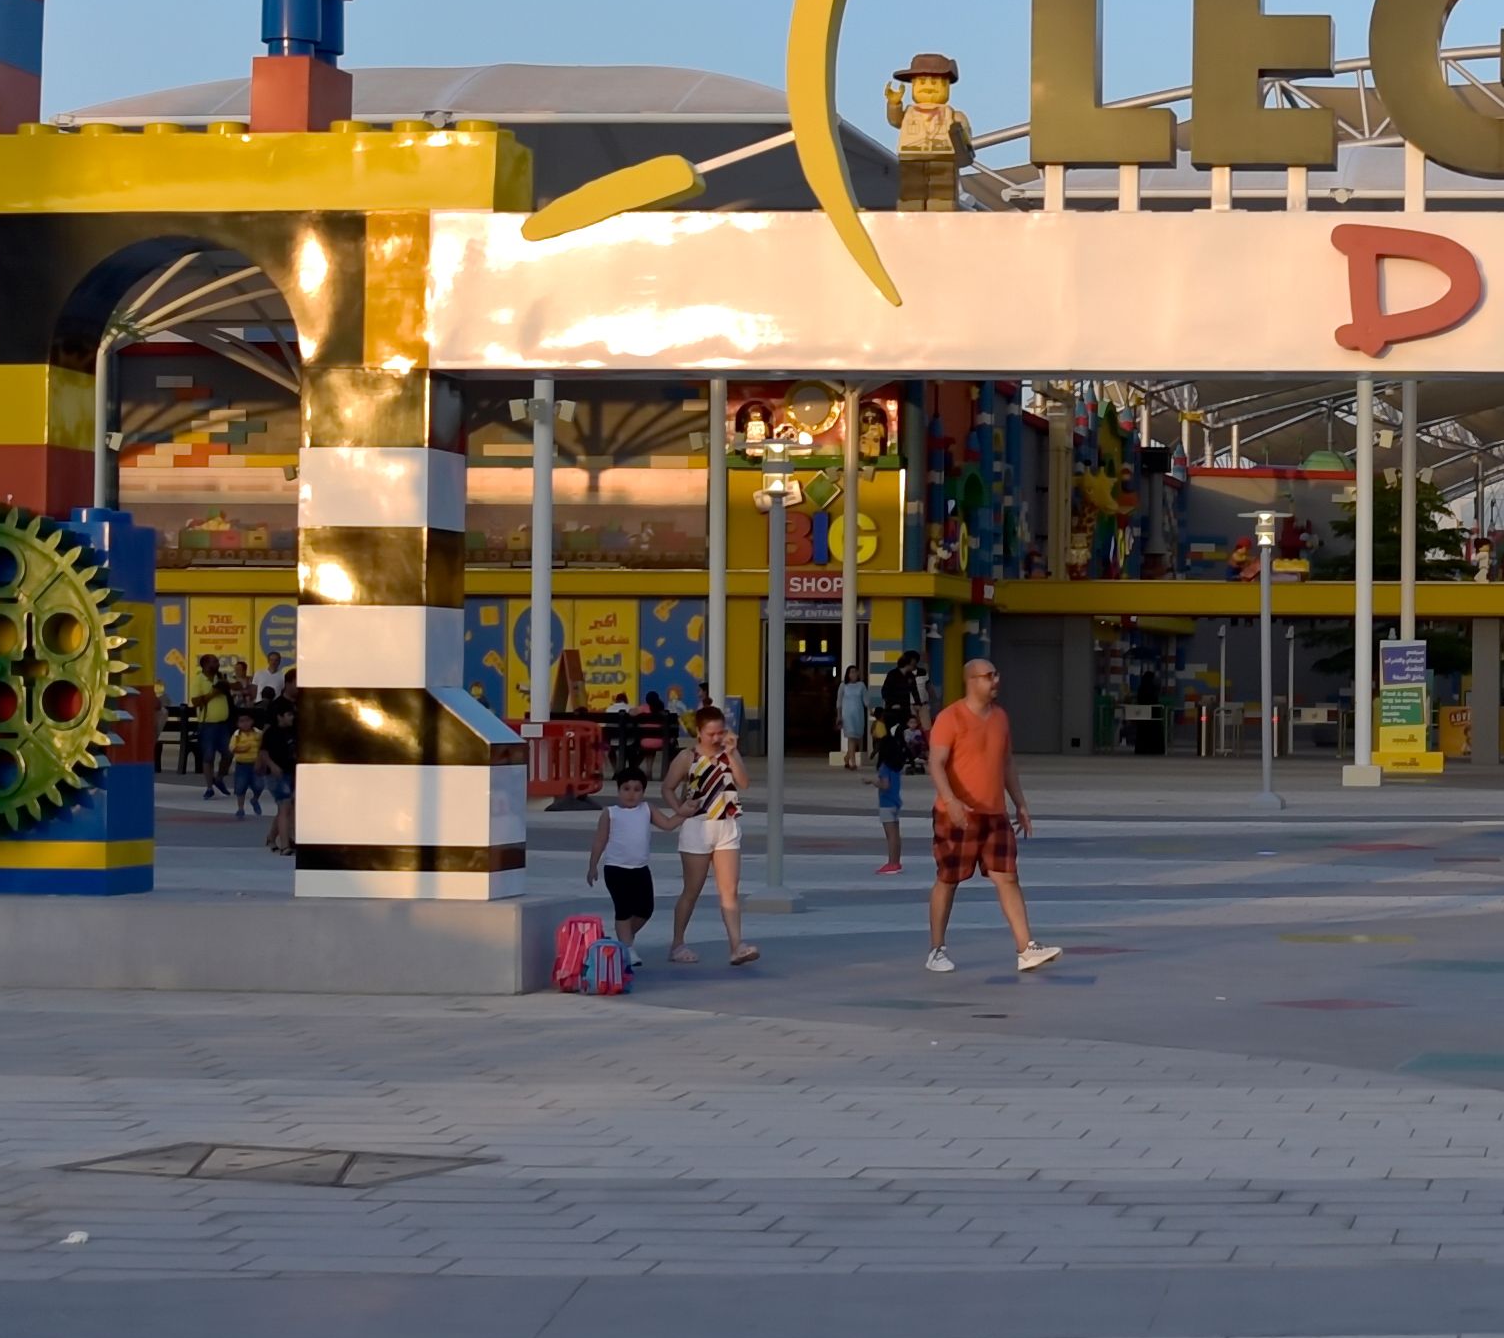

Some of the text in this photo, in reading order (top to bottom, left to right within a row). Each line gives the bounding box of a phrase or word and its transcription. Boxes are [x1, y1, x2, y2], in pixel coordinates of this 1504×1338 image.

[770, 511, 877, 566] BIG
[789, 576, 844, 593] SHOP
[785, 609, 803, 617] HOP
